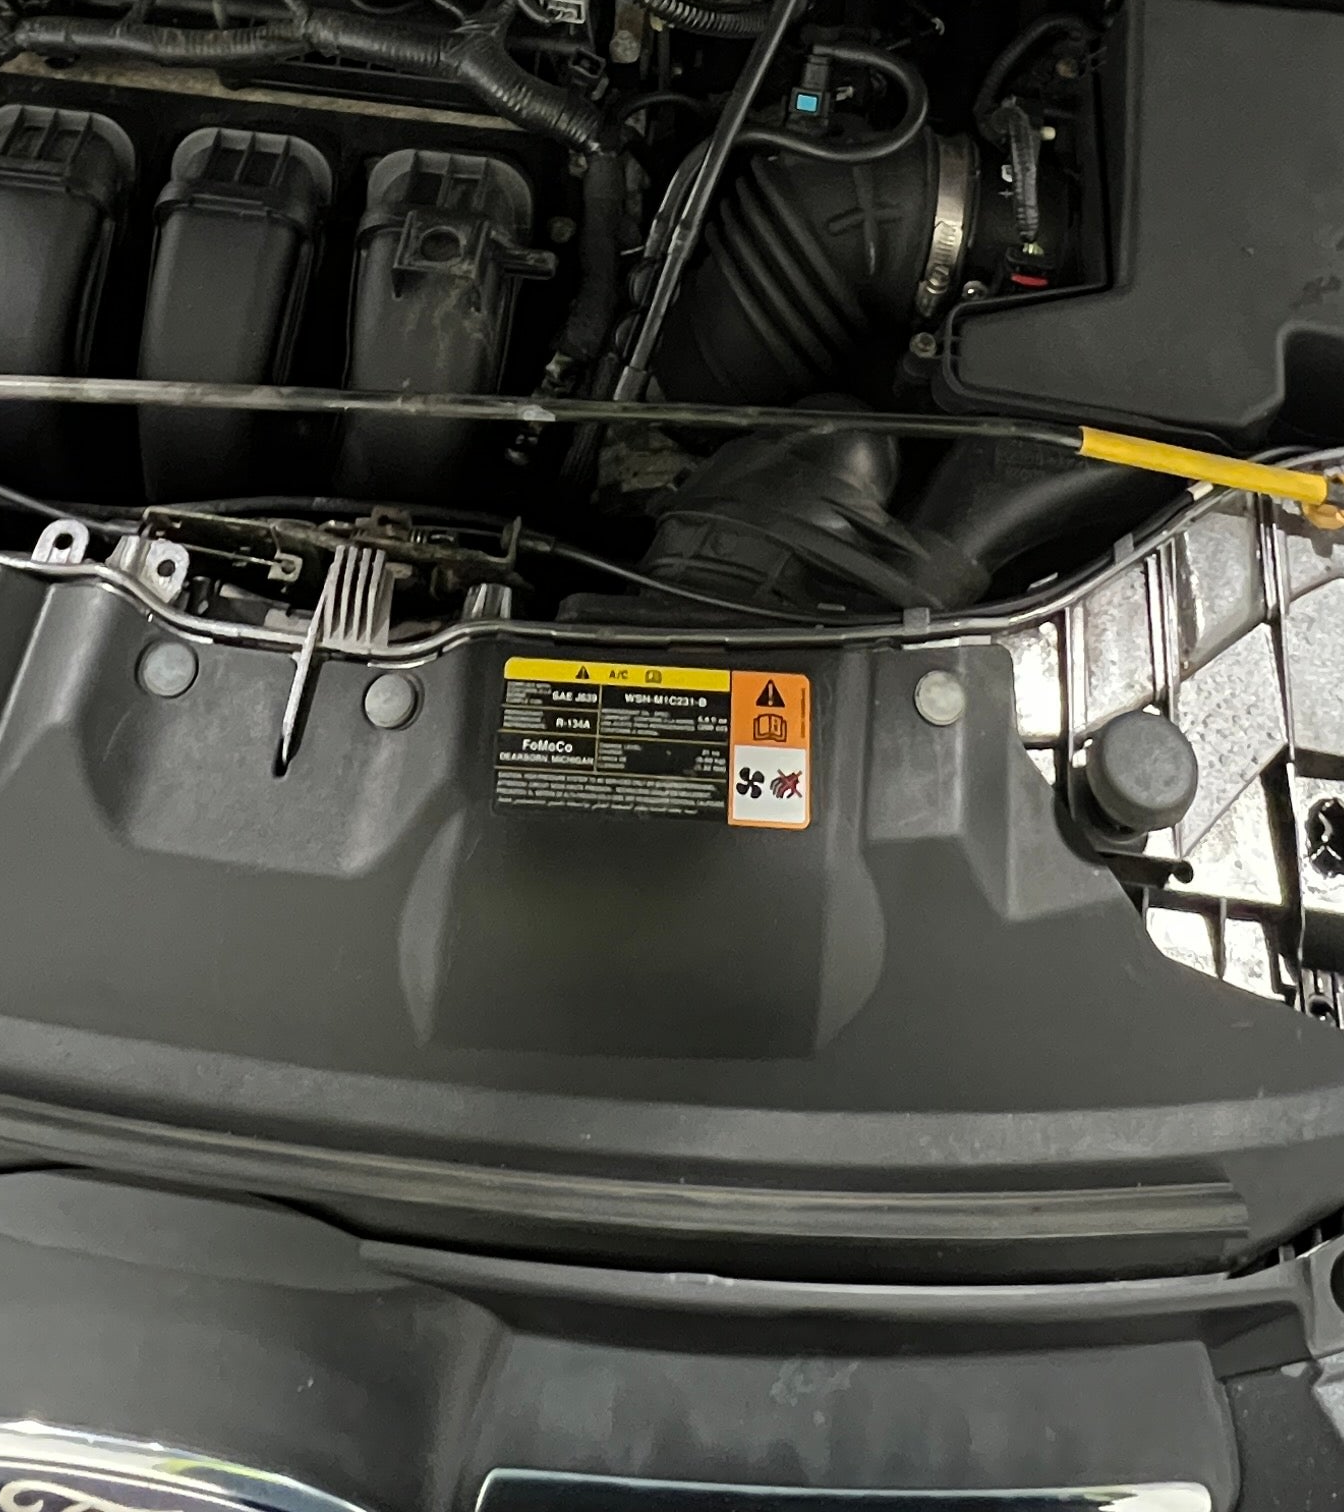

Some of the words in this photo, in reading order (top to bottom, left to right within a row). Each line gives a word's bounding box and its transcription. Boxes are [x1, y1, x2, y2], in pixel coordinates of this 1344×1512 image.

[609, 670, 629, 680] A/C
[552, 690, 573, 702] SAE
[521, 738, 573, 753] FoMoCo
